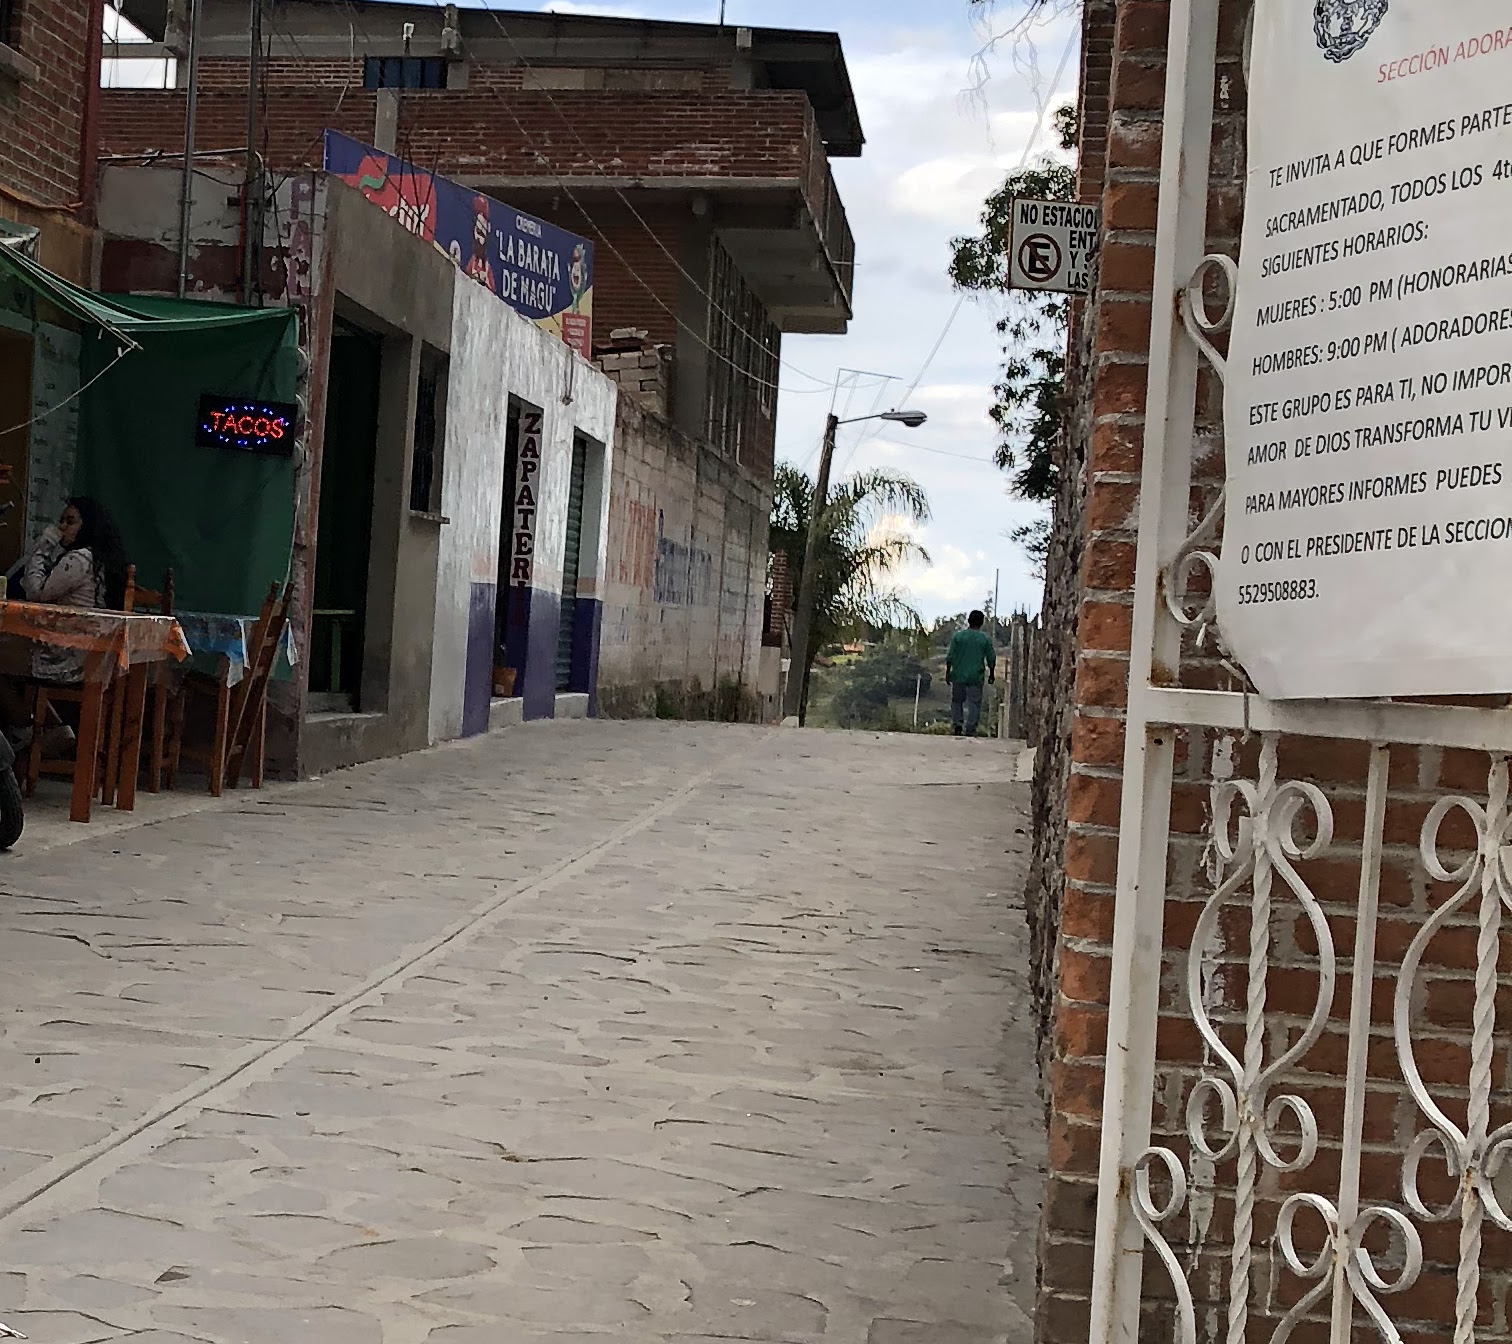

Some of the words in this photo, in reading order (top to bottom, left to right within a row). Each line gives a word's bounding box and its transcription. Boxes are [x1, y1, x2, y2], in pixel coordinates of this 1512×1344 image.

[1377, 43, 1450, 84] SECCIÓN
[1269, 167, 1283, 190] TE
[1286, 153, 1331, 183] INVITA
[1334, 149, 1345, 169] A
[1350, 138, 1384, 166] QUE
[1387, 119, 1456, 156] FORMES
[1461, 103, 1512, 137] PARTE
[1020, 203, 1038, 225] NO
[1265, 189, 1386, 239] SACRAMENTADO,
[1390, 172, 1447, 205] TODOS
[1451, 164, 1483, 191] LOS
[517, 238, 561, 282] BARATA
[1069, 250, 1079, 269] Y
[1261, 239, 1339, 279] SIGUIENTES
[1343, 219, 1429, 258] HORARIOS:
[502, 268, 518, 301] DE
[1256, 294, 1317, 327] MUJERES
[1328, 289, 1362, 311] 5:00
[1369, 281, 1393, 303] PM
[1252, 344, 1325, 377] HOMBRES:
[1326, 337, 1362, 362] 9:00
[1363, 330, 1388, 355] PM
[1249, 402, 1279, 427] ESTE
[1282, 392, 1332, 421] GRUPO
[1334, 388, 1352, 410] ES
[1355, 381, 1395, 408] PARA
[1398, 377, 1418, 404] TI,
[1420, 372, 1448, 398] NO
[210, 411, 284, 439] TACOS
[1247, 444, 1288, 467] AMOR
[1294, 436, 1312, 459] DE
[1315, 429, 1351, 455] DIOS
[1354, 413, 1464, 449] TRANSFORMA
[1469, 409, 1492, 433] TU
[1245, 490, 1275, 515] PARA
[1278, 482, 1345, 510] MAYORES
[1348, 471, 1427, 501] INFORMES
[1435, 462, 1503, 491] PUEDES
[1255, 541, 1284, 563] CON
[1287, 539, 1303, 559] EL
[1306, 528, 1392, 556] PRESIDENTE
[1397, 525, 1418, 549] DE
[1421, 522, 1441, 546] LA
[1238, 578, 1320, 605] 5529508883.
